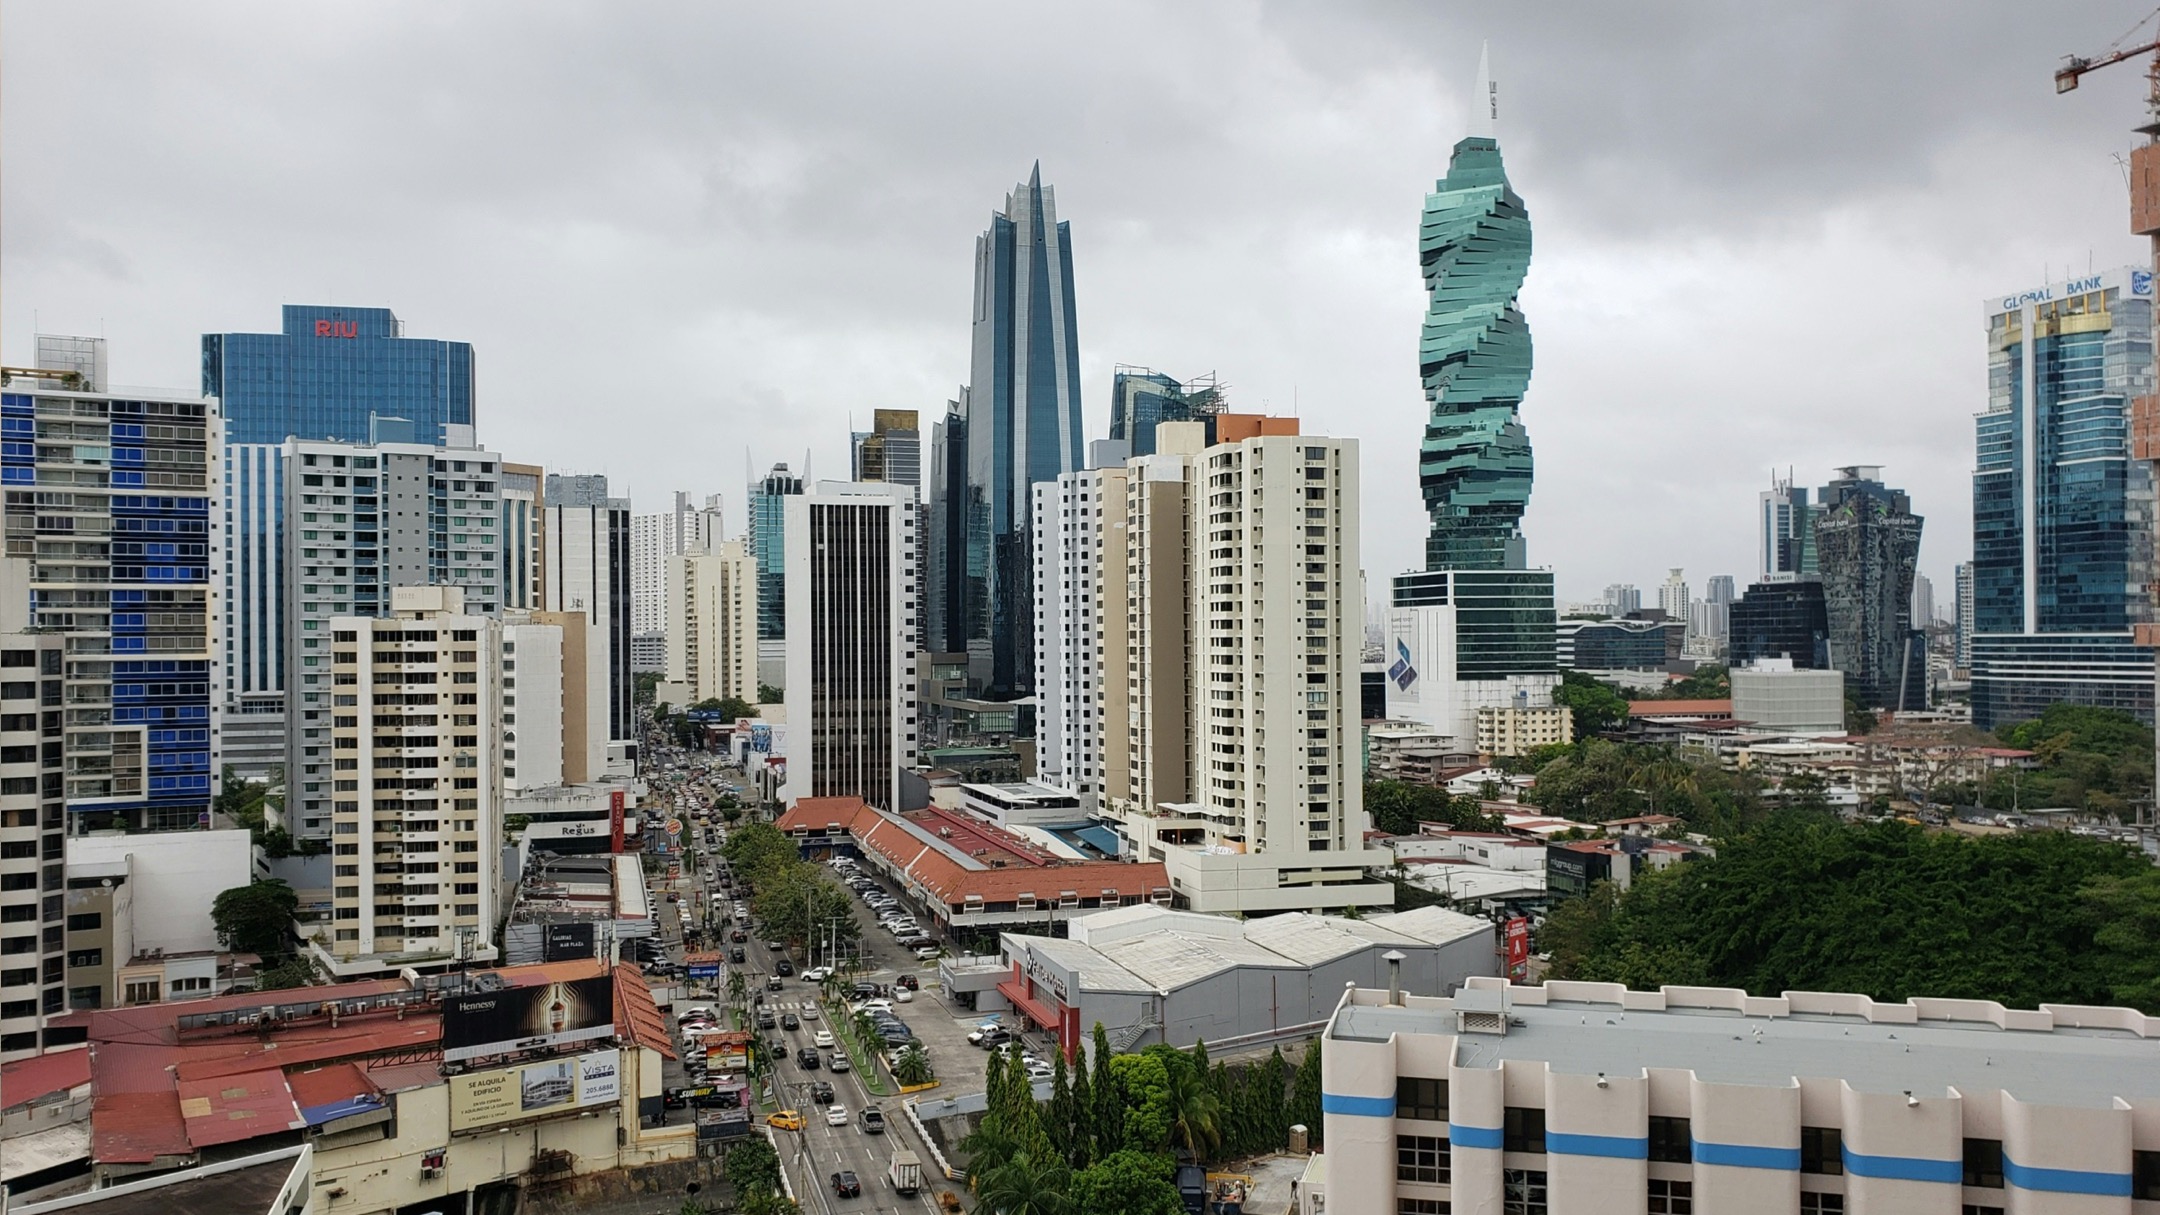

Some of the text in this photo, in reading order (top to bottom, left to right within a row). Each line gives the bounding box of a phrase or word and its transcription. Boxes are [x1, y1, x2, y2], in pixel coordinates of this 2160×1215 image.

[2066, 276, 2101, 295] BANK
[315, 319, 358, 338] RIU
[1878, 517, 1917, 526] Capital bank
[562, 827, 596, 836] Regus
[459, 1000, 497, 1012] Hennessy
[583, 1064, 615, 1075] VISTA
[477, 1077, 506, 1087] ALQUILA
[473, 1086, 502, 1097] EDIFICIO
[679, 1087, 714, 1098] SUBWAY
